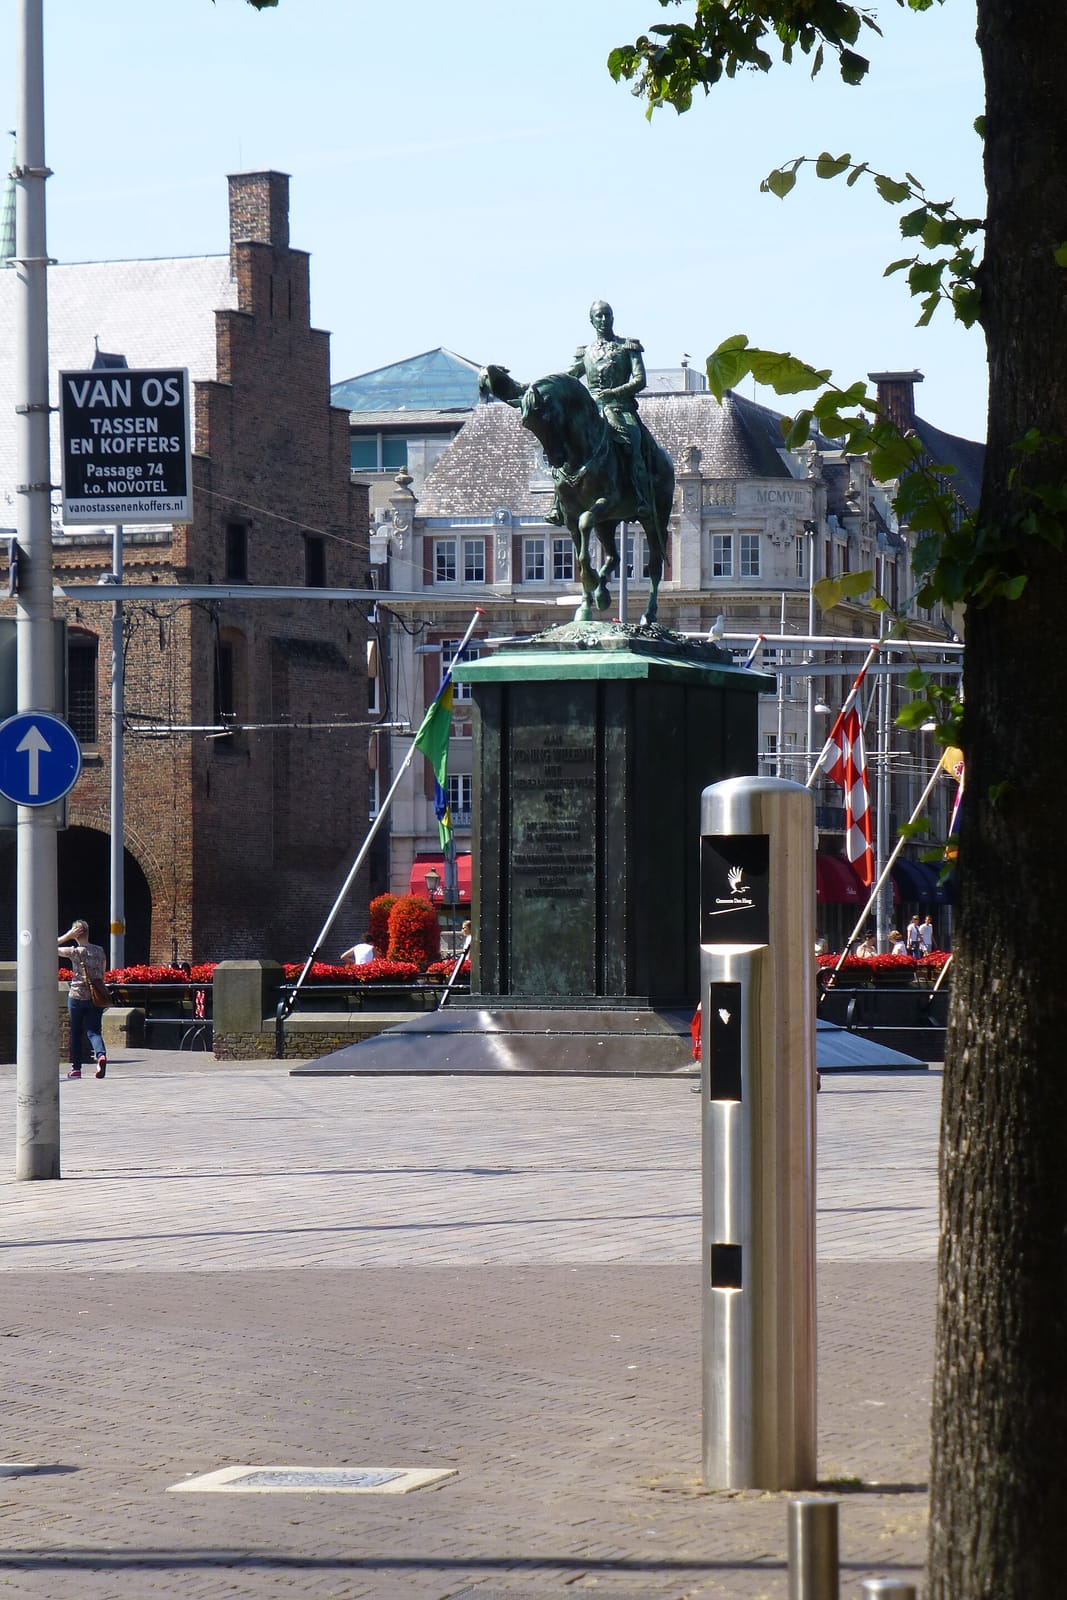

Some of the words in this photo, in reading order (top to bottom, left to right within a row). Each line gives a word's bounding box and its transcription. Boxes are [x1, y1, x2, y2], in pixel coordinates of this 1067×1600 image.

[68, 379, 131, 408] VAN
[141, 378, 180, 407] OS
[90, 417, 158, 434] TASSEN
[70, 438, 93, 454] EN
[101, 437, 180, 454] KOFFERS
[87, 463, 142, 479] Passage
[147, 463, 164, 476] 74
[84, 483, 104, 494] t.o.
[107, 480, 168, 493] NOVOTEL
[69, 499, 183, 512] vanostassenenkoffers.nl
